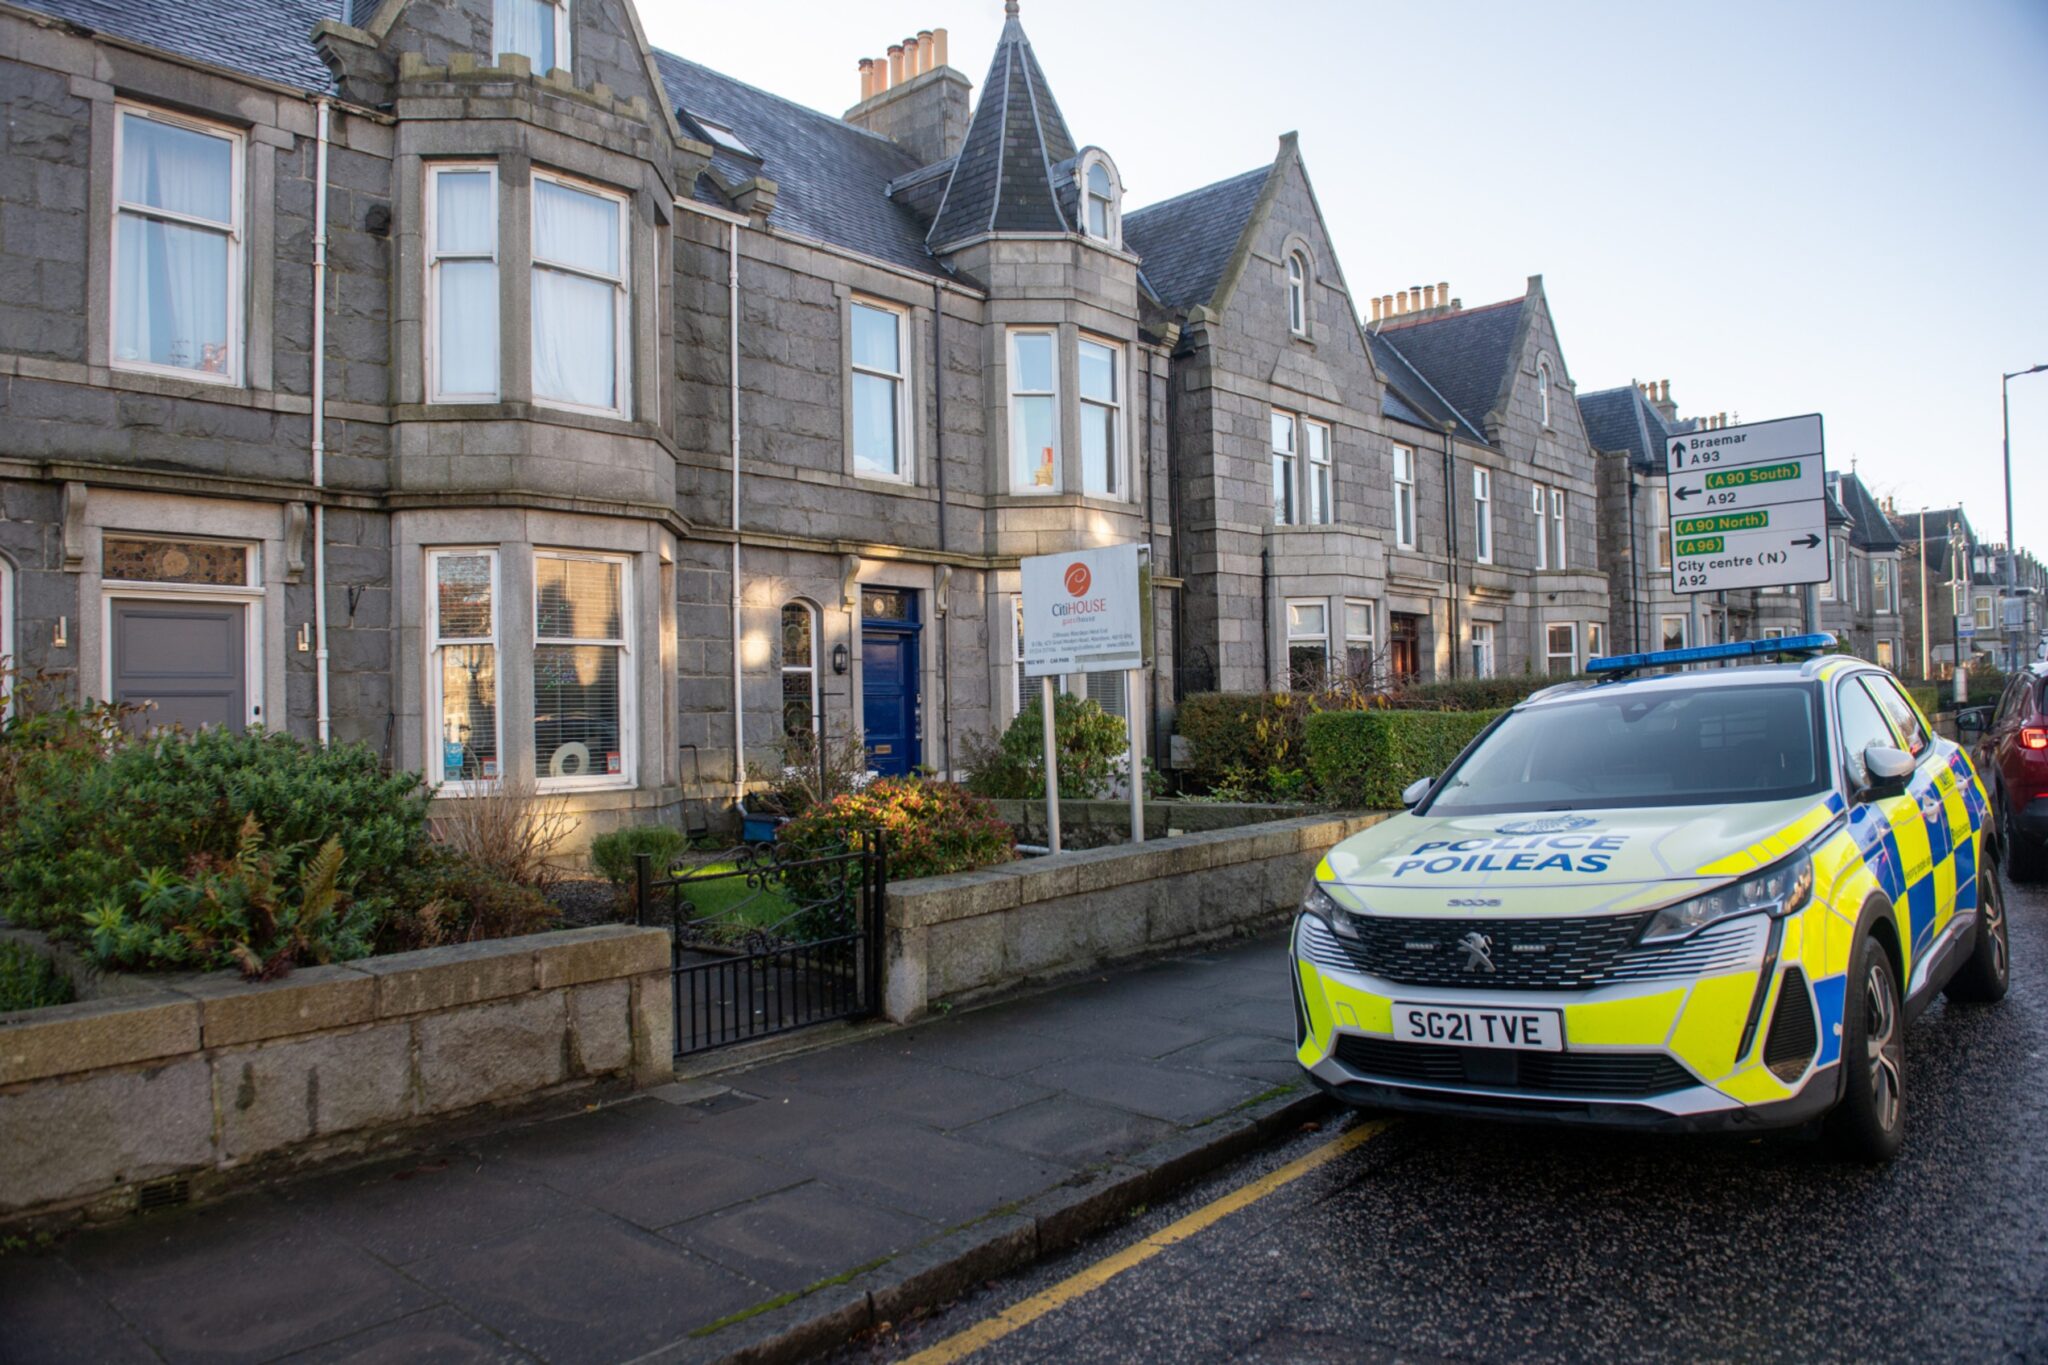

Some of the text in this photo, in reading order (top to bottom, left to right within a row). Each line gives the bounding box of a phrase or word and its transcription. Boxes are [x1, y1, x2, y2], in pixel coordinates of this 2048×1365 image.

[1690, 433, 1747, 449] Braemar
[1749, 464, 1799, 481] South)
[1718, 512, 1767, 529] North)
[1678, 561, 1705, 573] City
[1709, 556, 1753, 570] centre
[1052, 598, 1106, 617] CitiHOUSE
[1410, 835, 1631, 856] POLICE
[1392, 853, 1612, 878] POILEAS
[1408, 1010, 1542, 1046] SG21 TVE
